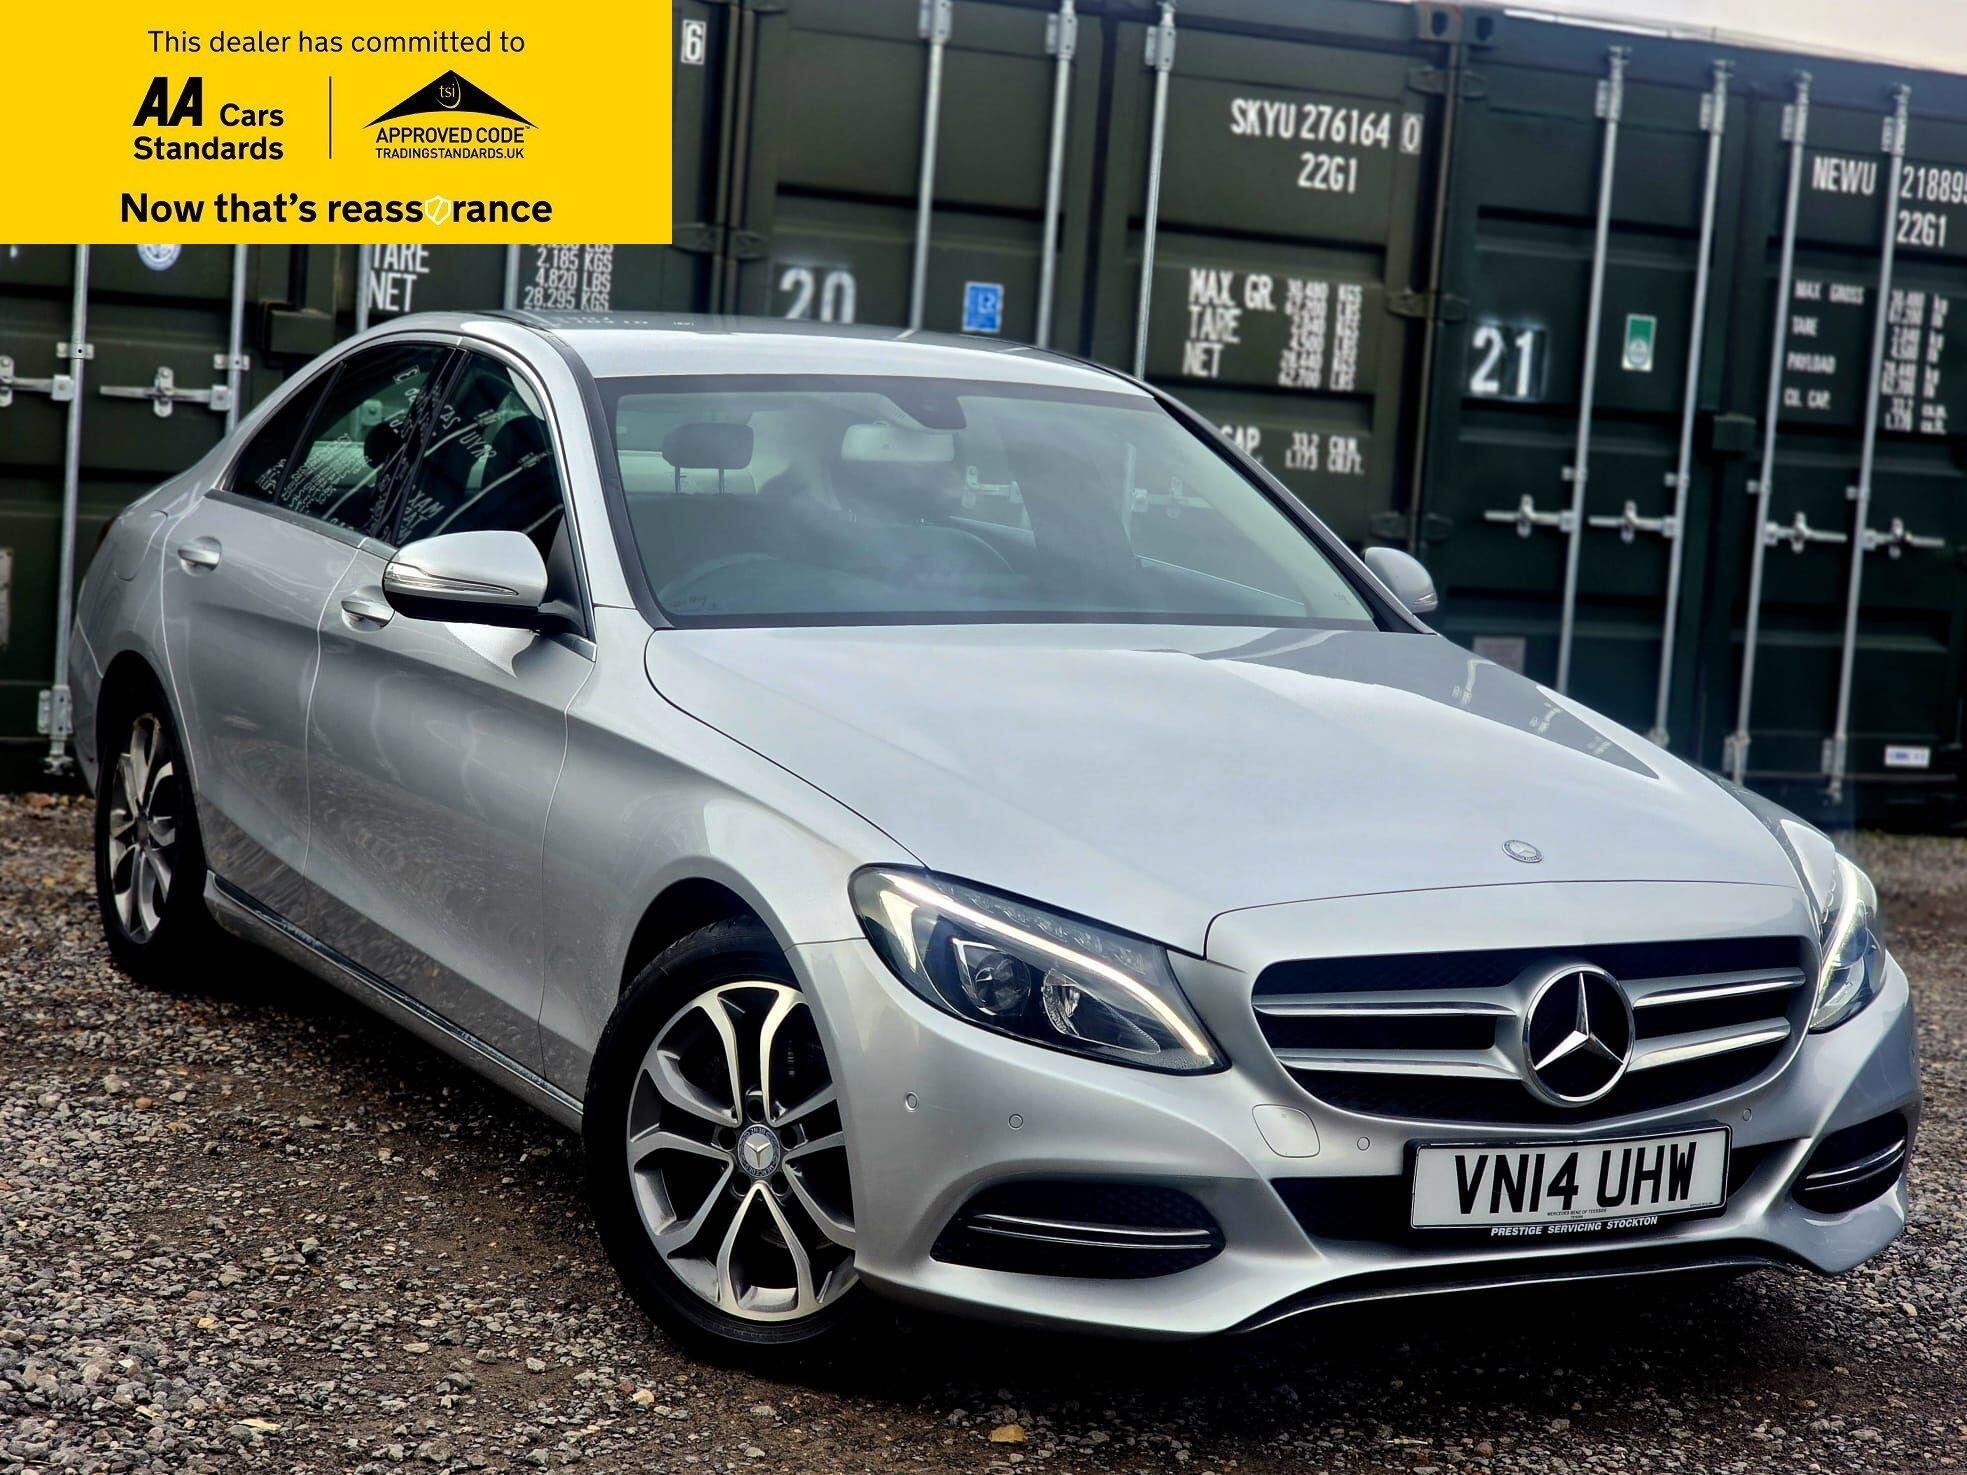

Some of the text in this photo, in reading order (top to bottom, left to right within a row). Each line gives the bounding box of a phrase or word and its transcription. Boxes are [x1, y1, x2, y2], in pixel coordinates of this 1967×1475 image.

[1230, 98, 1297, 139] SKYU
[1300, 103, 1392, 149] 276164
[1297, 152, 1358, 194] 22G1
[1811, 155, 1877, 196] NEWU
[1896, 208, 1948, 249] 22G1
[582, 273, 612, 293] LBS
[583, 251, 613, 274] KGS
[367, 270, 418, 313] NET
[579, 291, 610, 312] KGS
[779, 268, 857, 323] 20
[1188, 305, 1243, 345] TARE
[1182, 341, 1224, 378] NET
[1470, 326, 1534, 398] 21
[1454, 1141, 1697, 1215] VN14 UHW
[1491, 1216, 1658, 1237] PRESTIGE SERVICING STOCKTON
